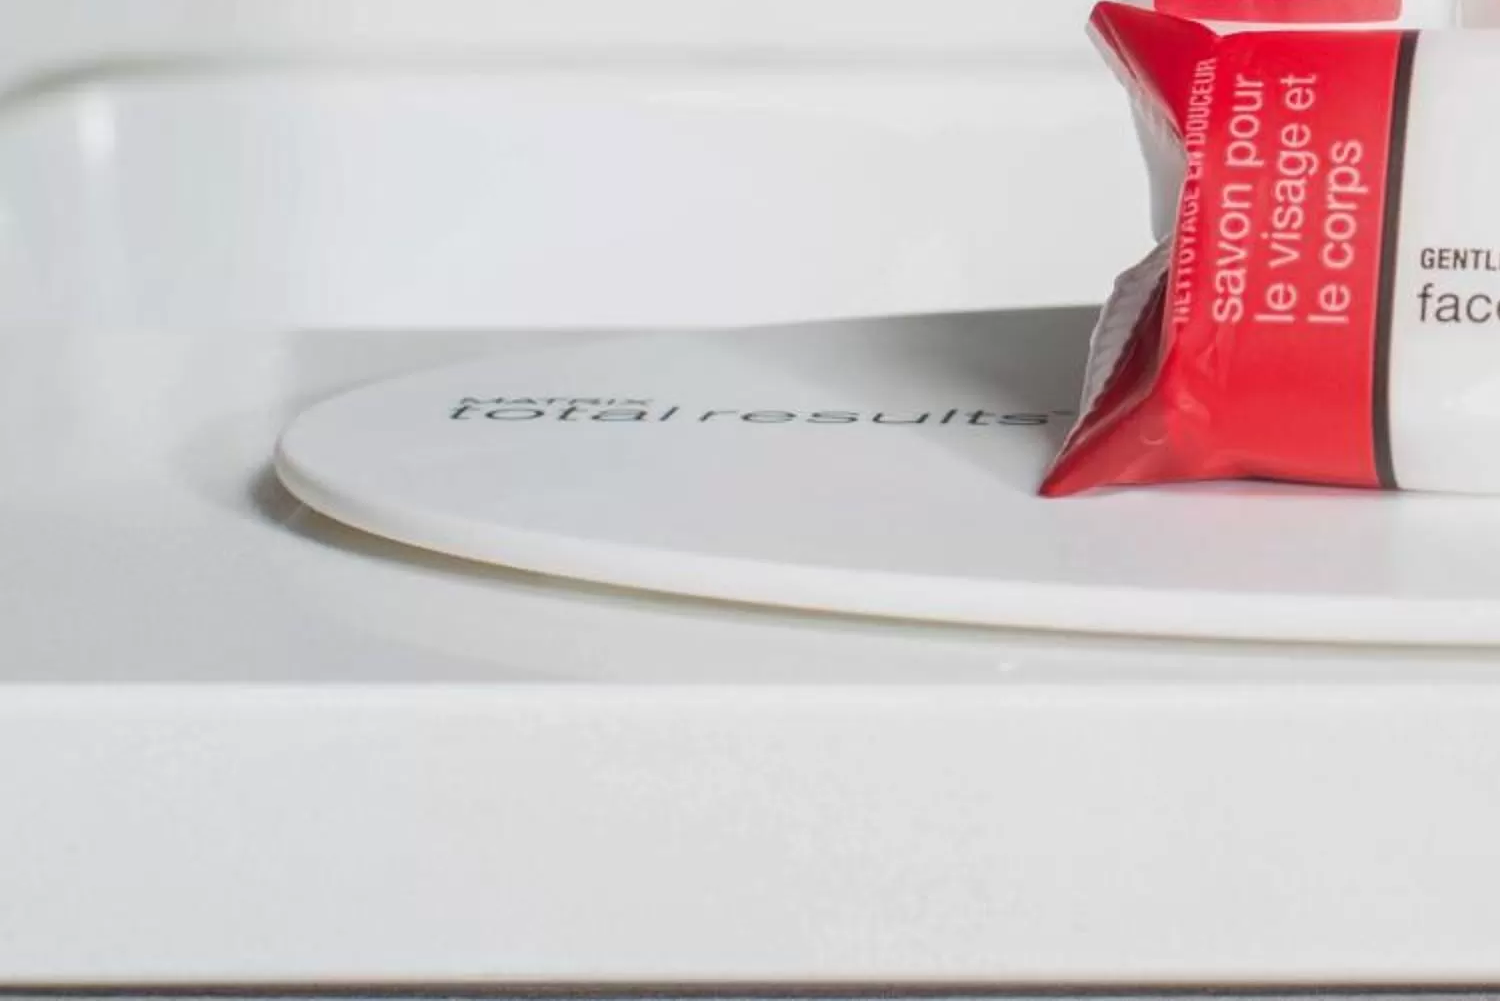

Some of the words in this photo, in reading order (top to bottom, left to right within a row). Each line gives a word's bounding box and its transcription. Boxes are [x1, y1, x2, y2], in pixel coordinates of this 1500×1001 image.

[1185, 57, 1218, 145] DOUCEUR
[1224, 73, 1265, 167] pour
[1280, 73, 1317, 111] et
[1260, 126, 1319, 269] visage
[1321, 139, 1369, 269] corps
[1212, 186, 1253, 323] savon
[1255, 283, 1299, 324] le
[1308, 283, 1351, 324] le
[449, 406, 681, 422] total
[699, 407, 1051, 426] results
